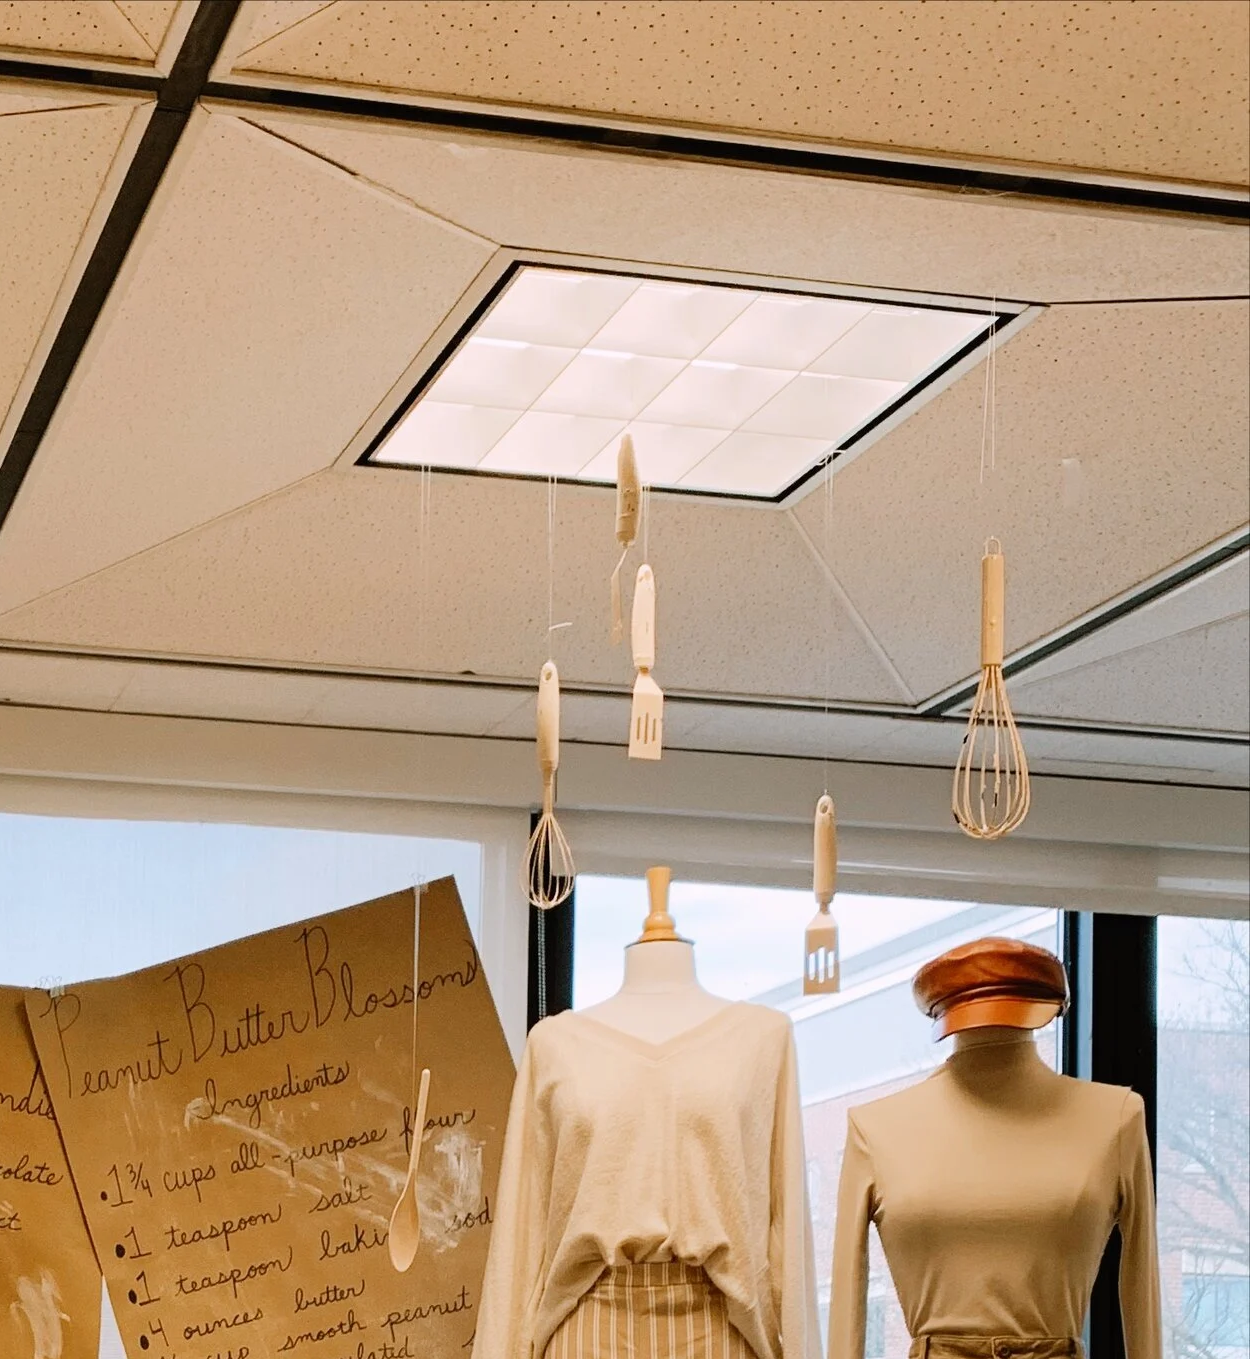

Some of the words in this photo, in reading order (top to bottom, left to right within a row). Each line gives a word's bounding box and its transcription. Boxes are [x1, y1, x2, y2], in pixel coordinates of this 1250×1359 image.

[40, 993, 183, 1099] Peanut
[163, 962, 311, 1064] Butter
[194, 1060, 350, 1129] Ingredients
[163, 1165, 217, 1204] cups
[399, 1106, 476, 1156] four
[123, 1227, 152, 1259] 1
[164, 1206, 283, 1252] teaspoon
[308, 1179, 373, 1214] salt
[135, 1271, 161, 1306] 1
[175, 1245, 294, 1298] teaspoon
[320, 1224, 389, 1260] baki
[445, 1196, 494, 1233] sod
[149, 1319, 169, 1348] 4
[182, 1307, 264, 1340] ounces
[295, 1280, 367, 1313] butter
[277, 1310, 367, 1354] smooth
[380, 1291, 473, 1341] peanut
